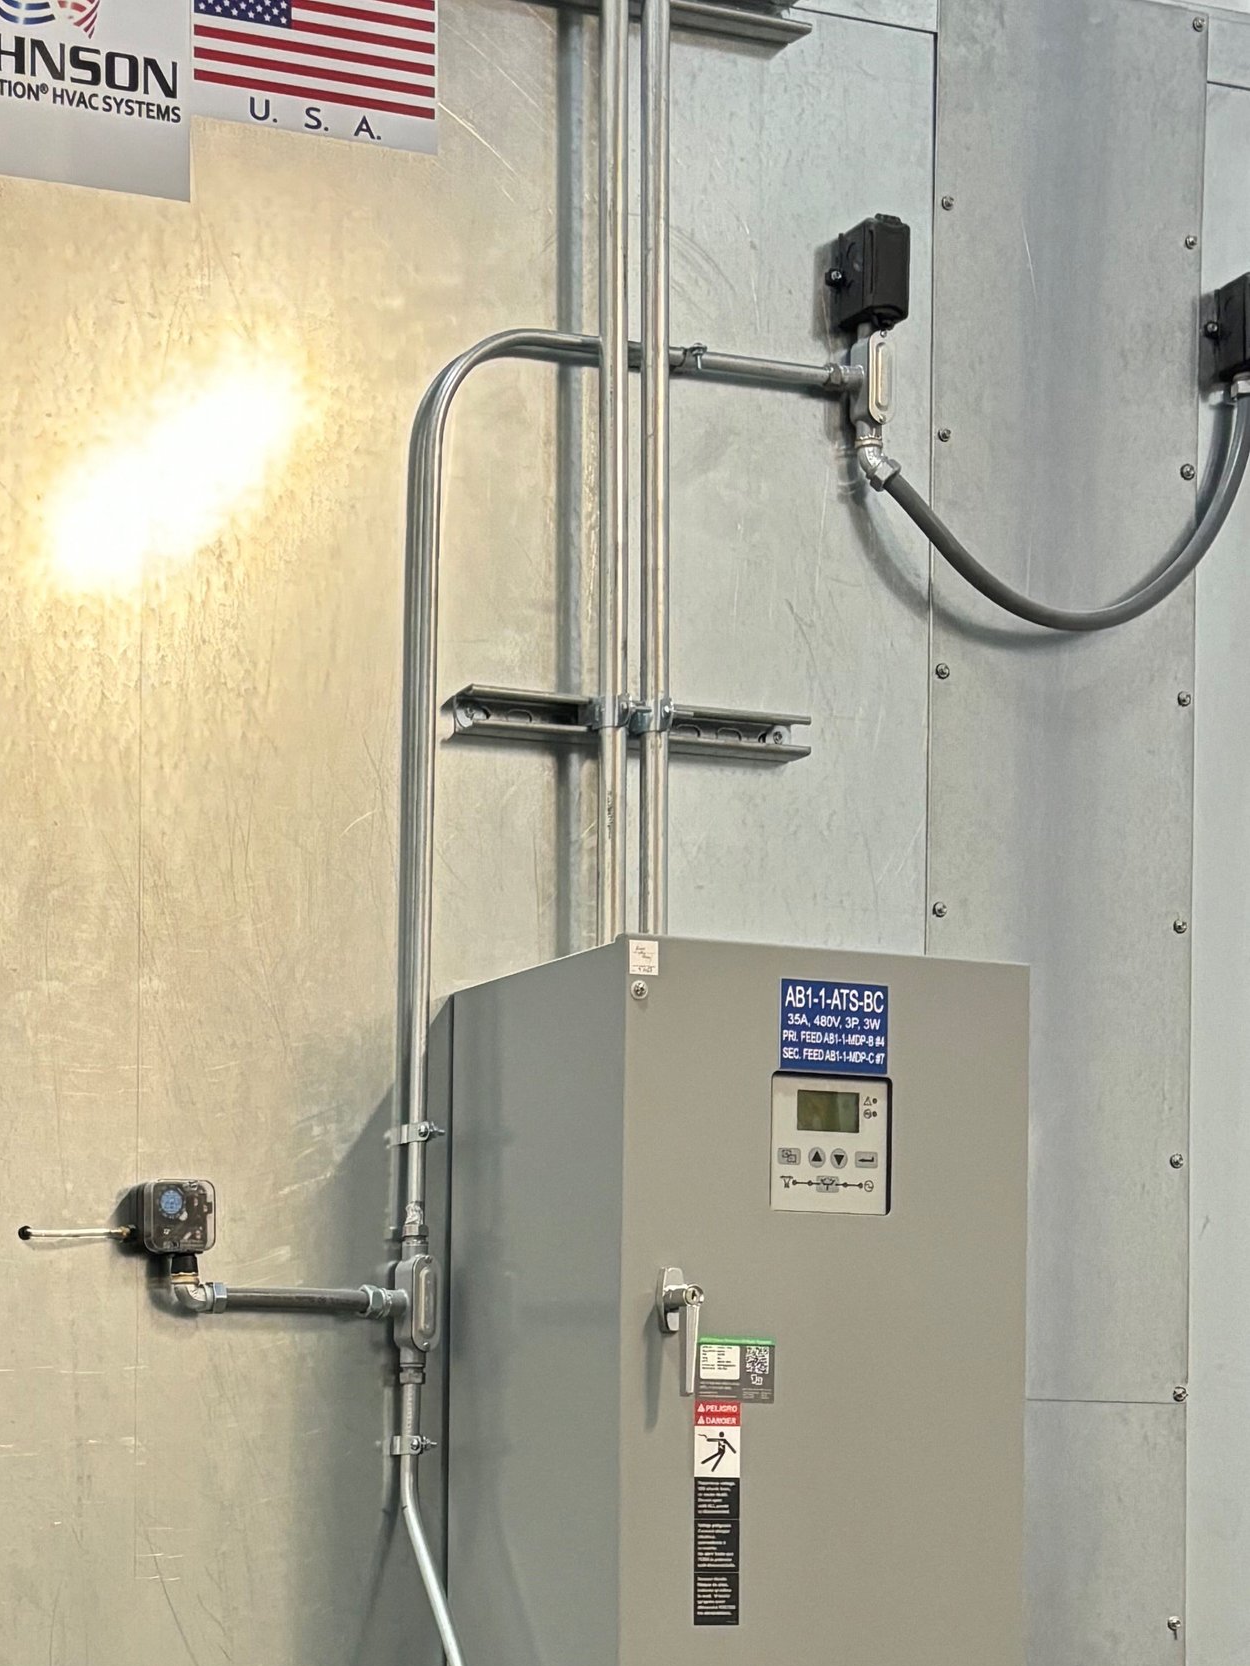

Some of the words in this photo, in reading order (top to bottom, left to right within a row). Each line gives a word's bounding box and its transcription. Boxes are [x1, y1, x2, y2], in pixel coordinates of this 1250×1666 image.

[52, 86, 99, 111] HVAC
[102, 95, 181, 124] SYSTEMS
[249, 96, 277, 124] U.
[304, 106, 329, 133] S.
[353, 115, 382, 141] A.
[785, 985, 885, 1013] AB1-1-ATS-BC
[787, 1013, 811, 1027] 35A,
[813, 1015, 842, 1029] 480V,
[845, 1017, 861, 1030] 3P,
[863, 1018, 881, 1030] 3W
[782, 1030, 798, 1042] PRI.
[800, 1031, 822, 1043] FEED
[782, 1047, 801, 1059] SEC.
[803, 1048, 824, 1060] FEED
